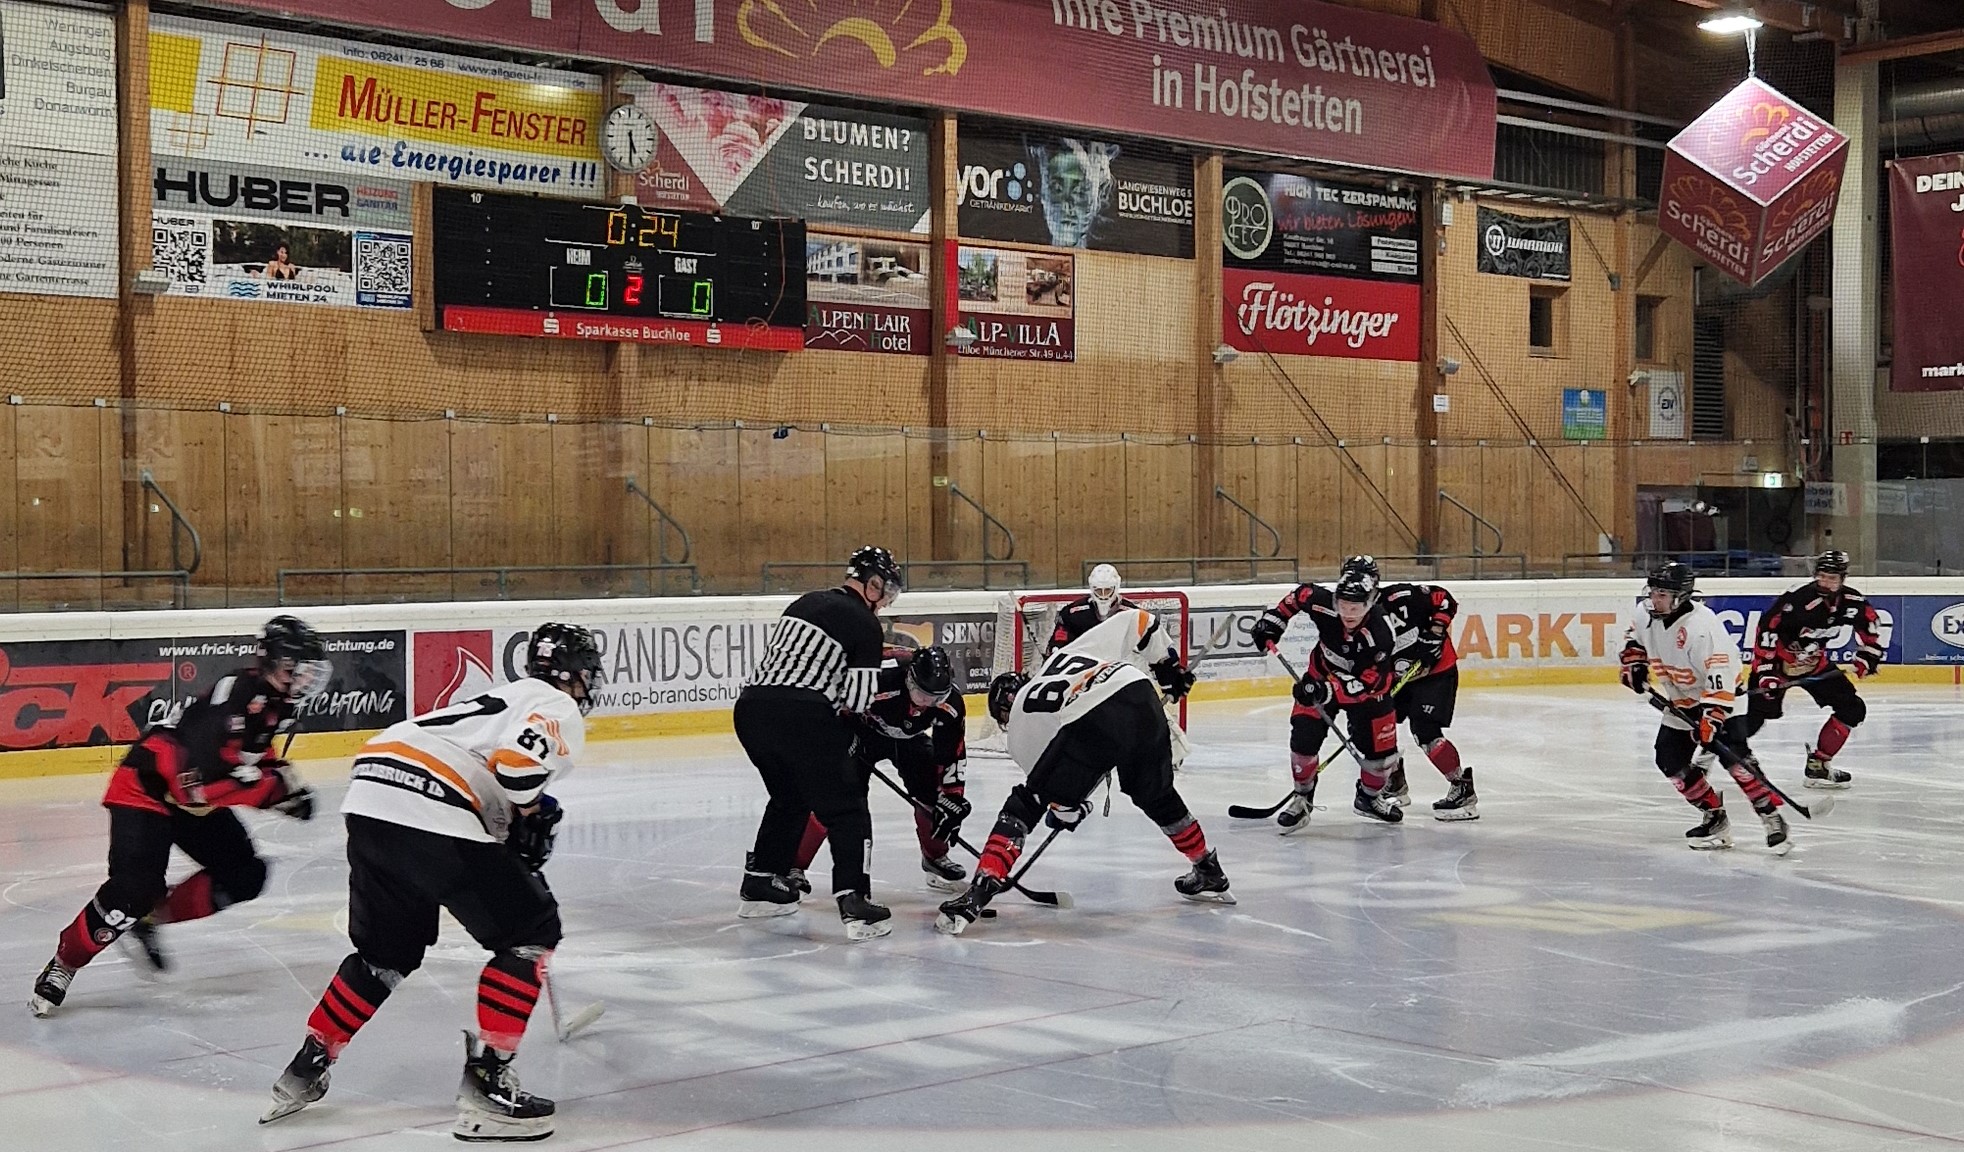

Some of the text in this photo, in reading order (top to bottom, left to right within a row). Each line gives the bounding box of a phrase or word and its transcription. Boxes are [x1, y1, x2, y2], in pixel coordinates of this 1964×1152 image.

[50, 40, 111, 60] Augsburg
[1131, 0, 1284, 62] Premium
[1290, 25, 1436, 88] Gärtnerei
[67, 82, 111, 98] Burgau
[1153, 55, 1362, 135] in Hofstetten
[803, 116, 911, 151] BLUMEN?
[391, 140, 561, 188] Energiesparer
[1733, 117, 1819, 186] Scherdi
[803, 157, 911, 191] SCHERDI!
[154, 168, 349, 217] HUBER
[1118, 192, 1193, 217] BUCHLOE
[1315, 187, 1338, 202] TEC
[1667, 200, 1749, 265] Scherdi
[1761, 191, 1835, 263] Scherdi
[1507, 236, 1563, 253] WARRIOR
[266, 281, 338, 294] WHIRLPOOL
[623, 274, 644, 306] 2
[807, 305, 911, 333] ALPENFLAIR
[968, 316, 1061, 346] ALP-VILLA
[1237, 282, 1398, 348] Flötzinger
[577, 322, 690, 342] Sparkasse Buchloe
[870, 331, 911, 351] Hotel
[942, 622, 997, 644] SENG
[1190, 615, 1257, 649] LUS
[1456, 613, 1617, 659] ARKT
[590, 624, 777, 684] RANDSCHU
[592, 684, 744, 709] ww.cp-brandschu
[943, 759, 967, 785] 25
